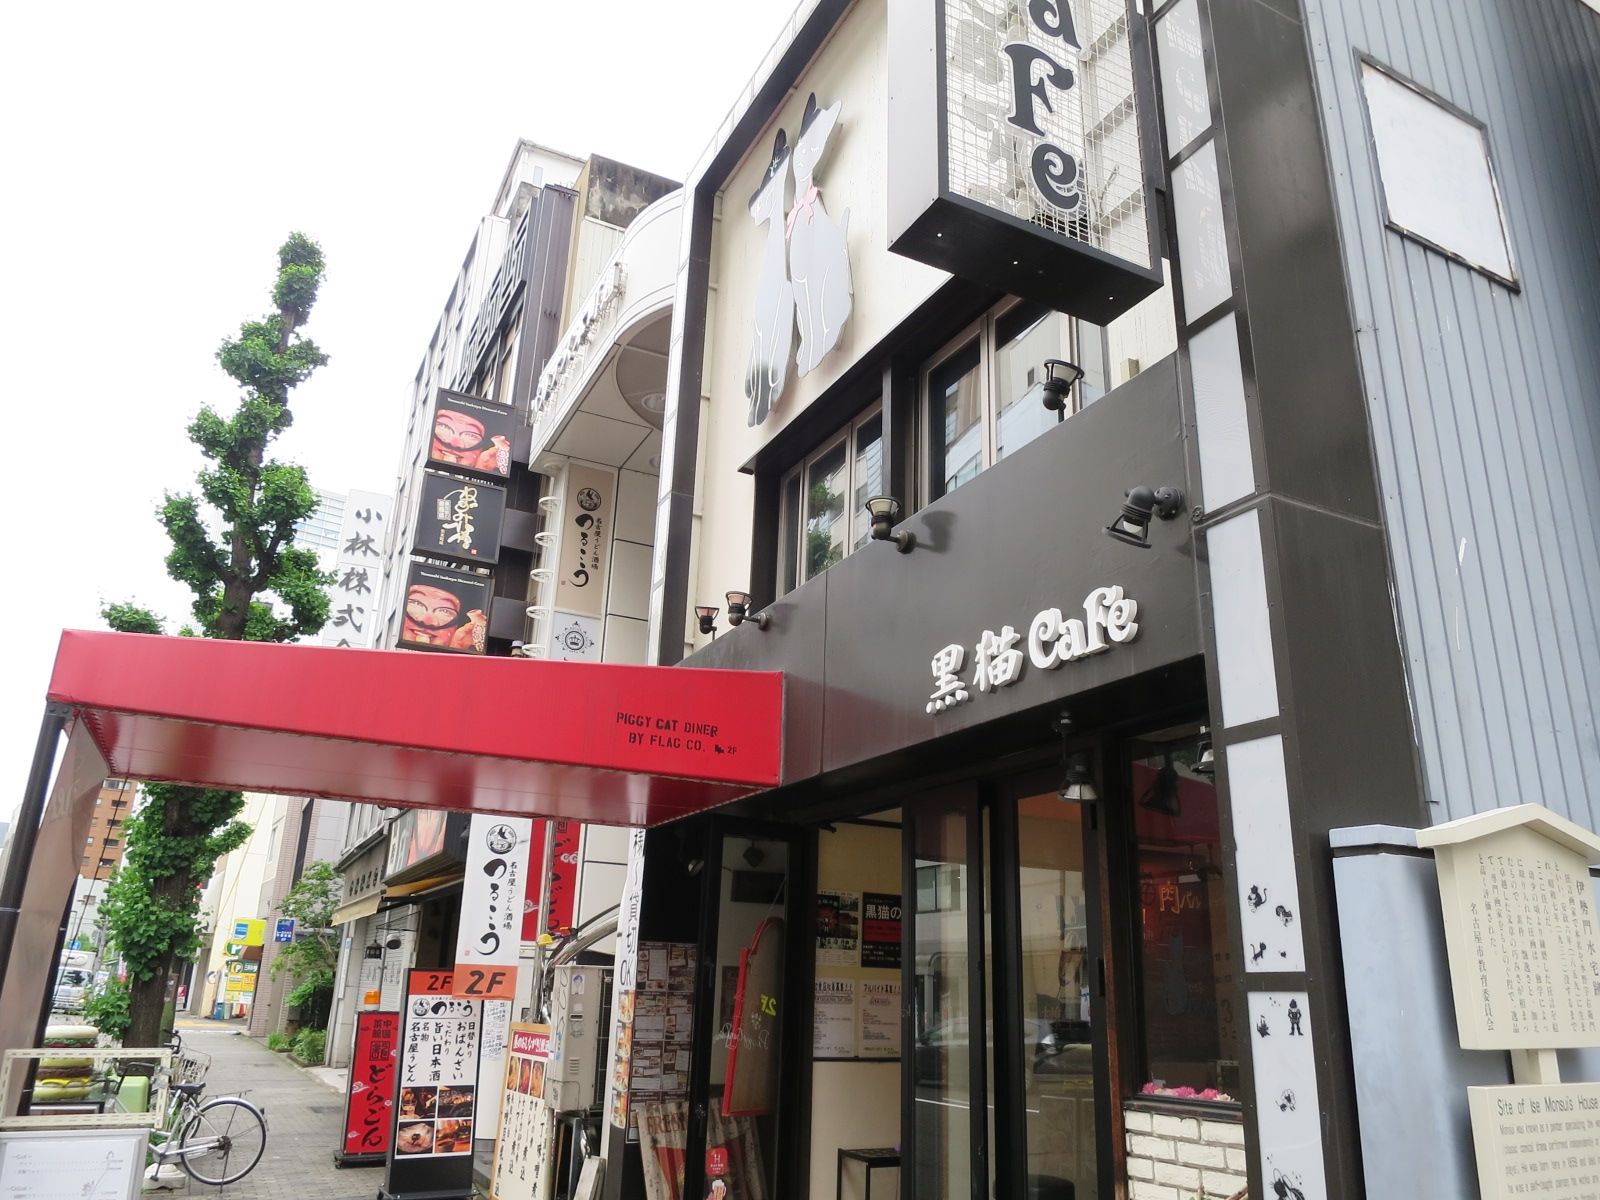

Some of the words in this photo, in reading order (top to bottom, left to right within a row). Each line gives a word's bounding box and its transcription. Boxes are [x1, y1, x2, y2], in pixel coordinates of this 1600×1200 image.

[616, 711, 652, 728] PIGGY
[656, 718, 679, 732] CAT
[684, 721, 718, 738] DINER
[628, 732, 644, 746] BY
[650, 735, 682, 749] FLAG
[503, 861, 518, 930] 名古屋うどん酒場
[427, 974, 453, 991] 2F
[465, 970, 507, 995] 2F
[1471, 902, 1494, 1031] 名古屋市教育委員会
[420, 1022, 429, 1042] 名物
[466, 1021, 476, 1059] 日替わり
[406, 1022, 420, 1082] 名古屋うどん
[453, 1021, 467, 1080] おばんざい
[361, 1064, 393, 1147] どらごん
[1497, 1098, 1513, 1116] Site
[1517, 1098, 1525, 1114] of
[1578, 1095, 1599, 1110] House
